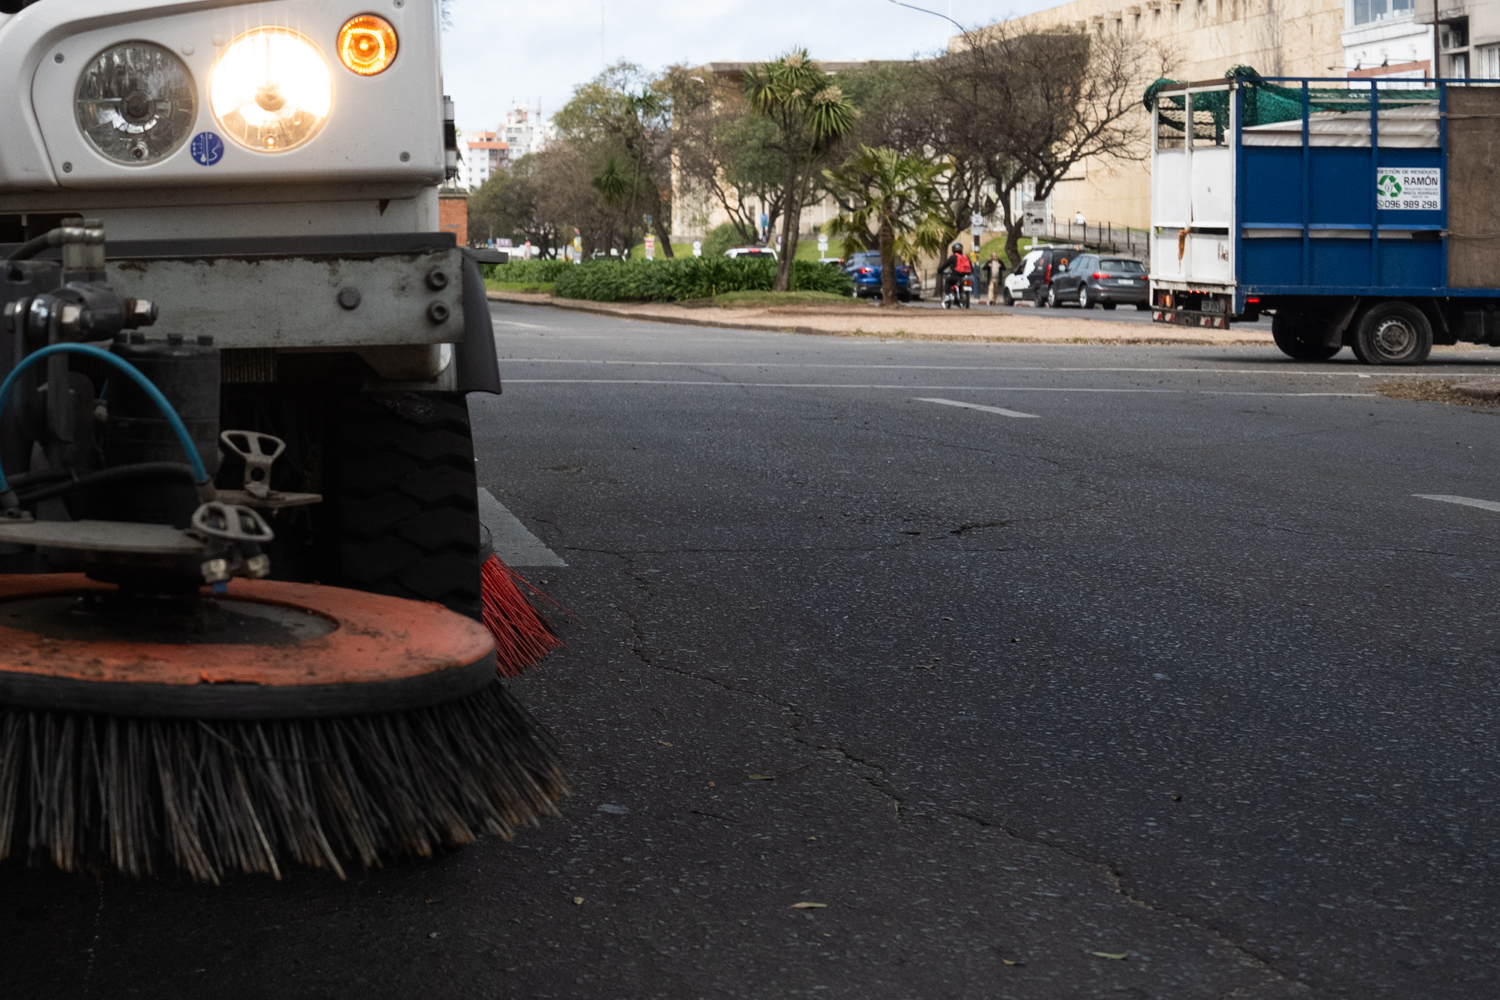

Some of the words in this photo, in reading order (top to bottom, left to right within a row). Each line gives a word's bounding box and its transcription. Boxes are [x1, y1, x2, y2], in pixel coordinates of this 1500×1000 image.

[1404, 176, 1438, 186] RAMÓN
[1384, 200, 1401, 209] 096
[1403, 200, 1420, 209] 989
[1422, 200, 1438, 209] 298
